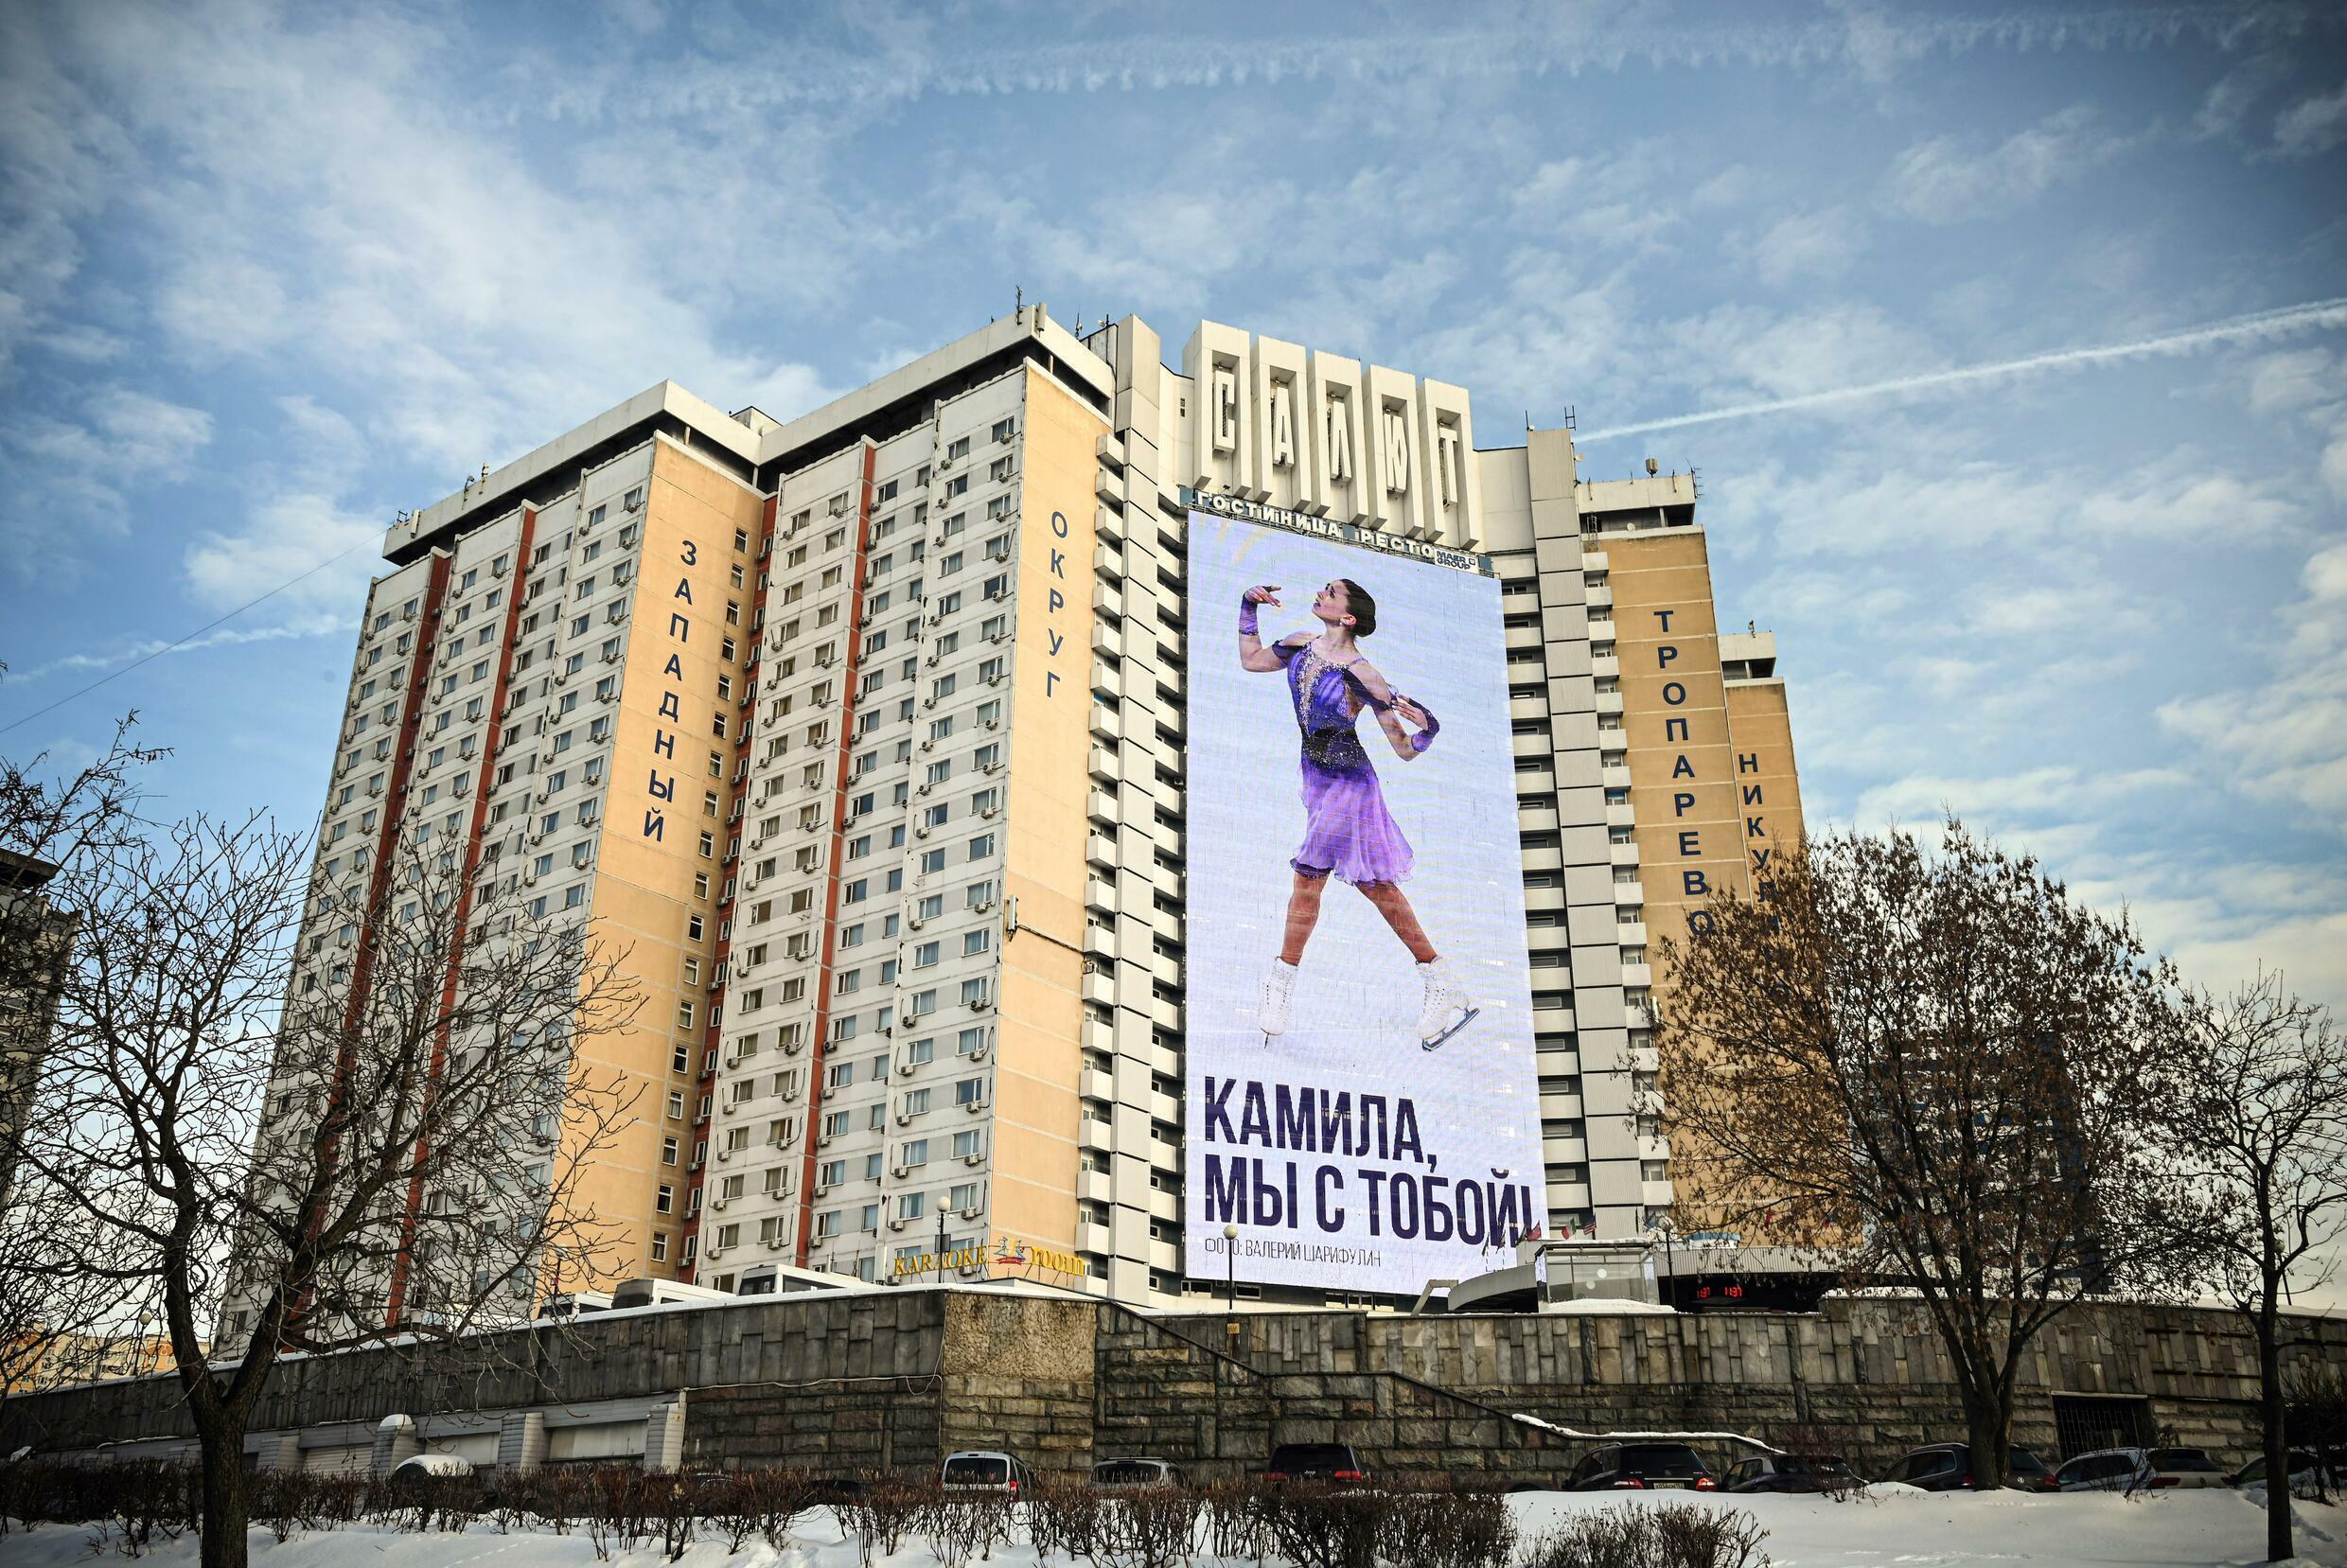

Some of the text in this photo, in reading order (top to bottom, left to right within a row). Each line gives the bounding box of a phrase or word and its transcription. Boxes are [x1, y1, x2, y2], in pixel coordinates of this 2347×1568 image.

[1212, 370, 1458, 509] САЛЮТ
[1196, 491, 1436, 558] ГОСТИНИЦА РЕСТО
[1437, 557, 1471, 570] GROUP
[1047, 510, 1069, 698] ОКРУГ
[644, 539, 697, 842] ЗАПАДНЫЙ
[1653, 609, 1716, 936] ТРОПАРЕВО
[1205, 1076, 1438, 1173] КАМИЛА,
[1205, 1154, 1297, 1229] МЫ
[1315, 1165, 1345, 1233] С
[1205, 1237, 1381, 1267] ФОО: ВАЛЕРИЙ ШАРИФУЛИН
